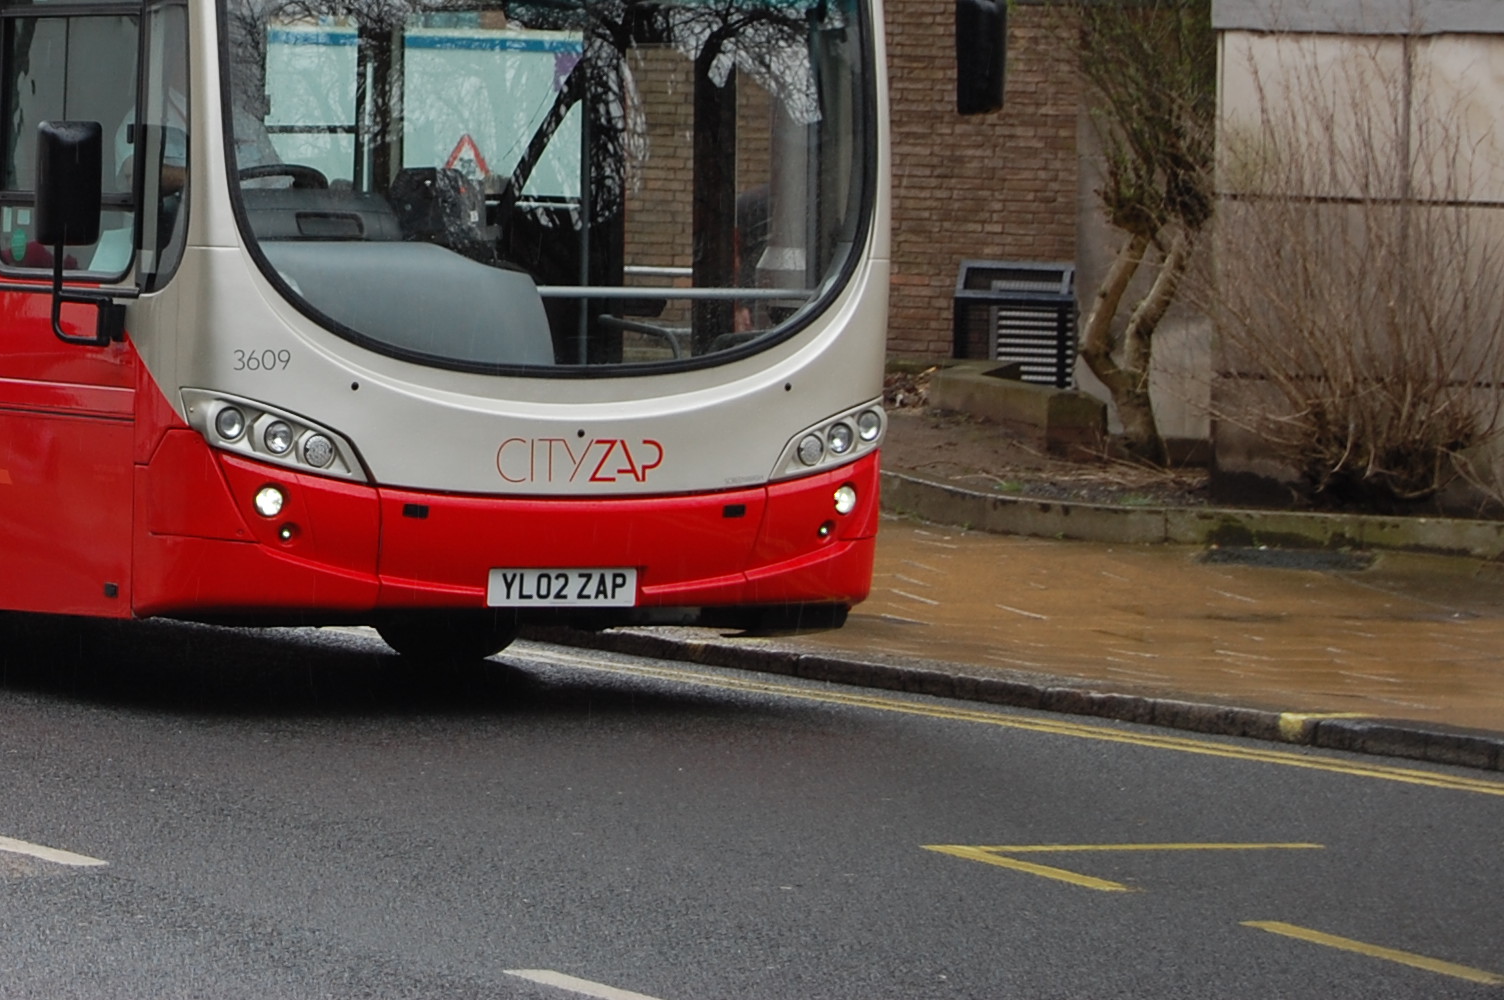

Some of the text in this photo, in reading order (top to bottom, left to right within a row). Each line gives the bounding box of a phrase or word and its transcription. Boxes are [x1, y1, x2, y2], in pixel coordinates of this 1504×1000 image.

[232, 349, 291, 371] 3609
[496, 437, 664, 483] CITYZAP
[502, 572, 627, 600] YL02 ZAP
